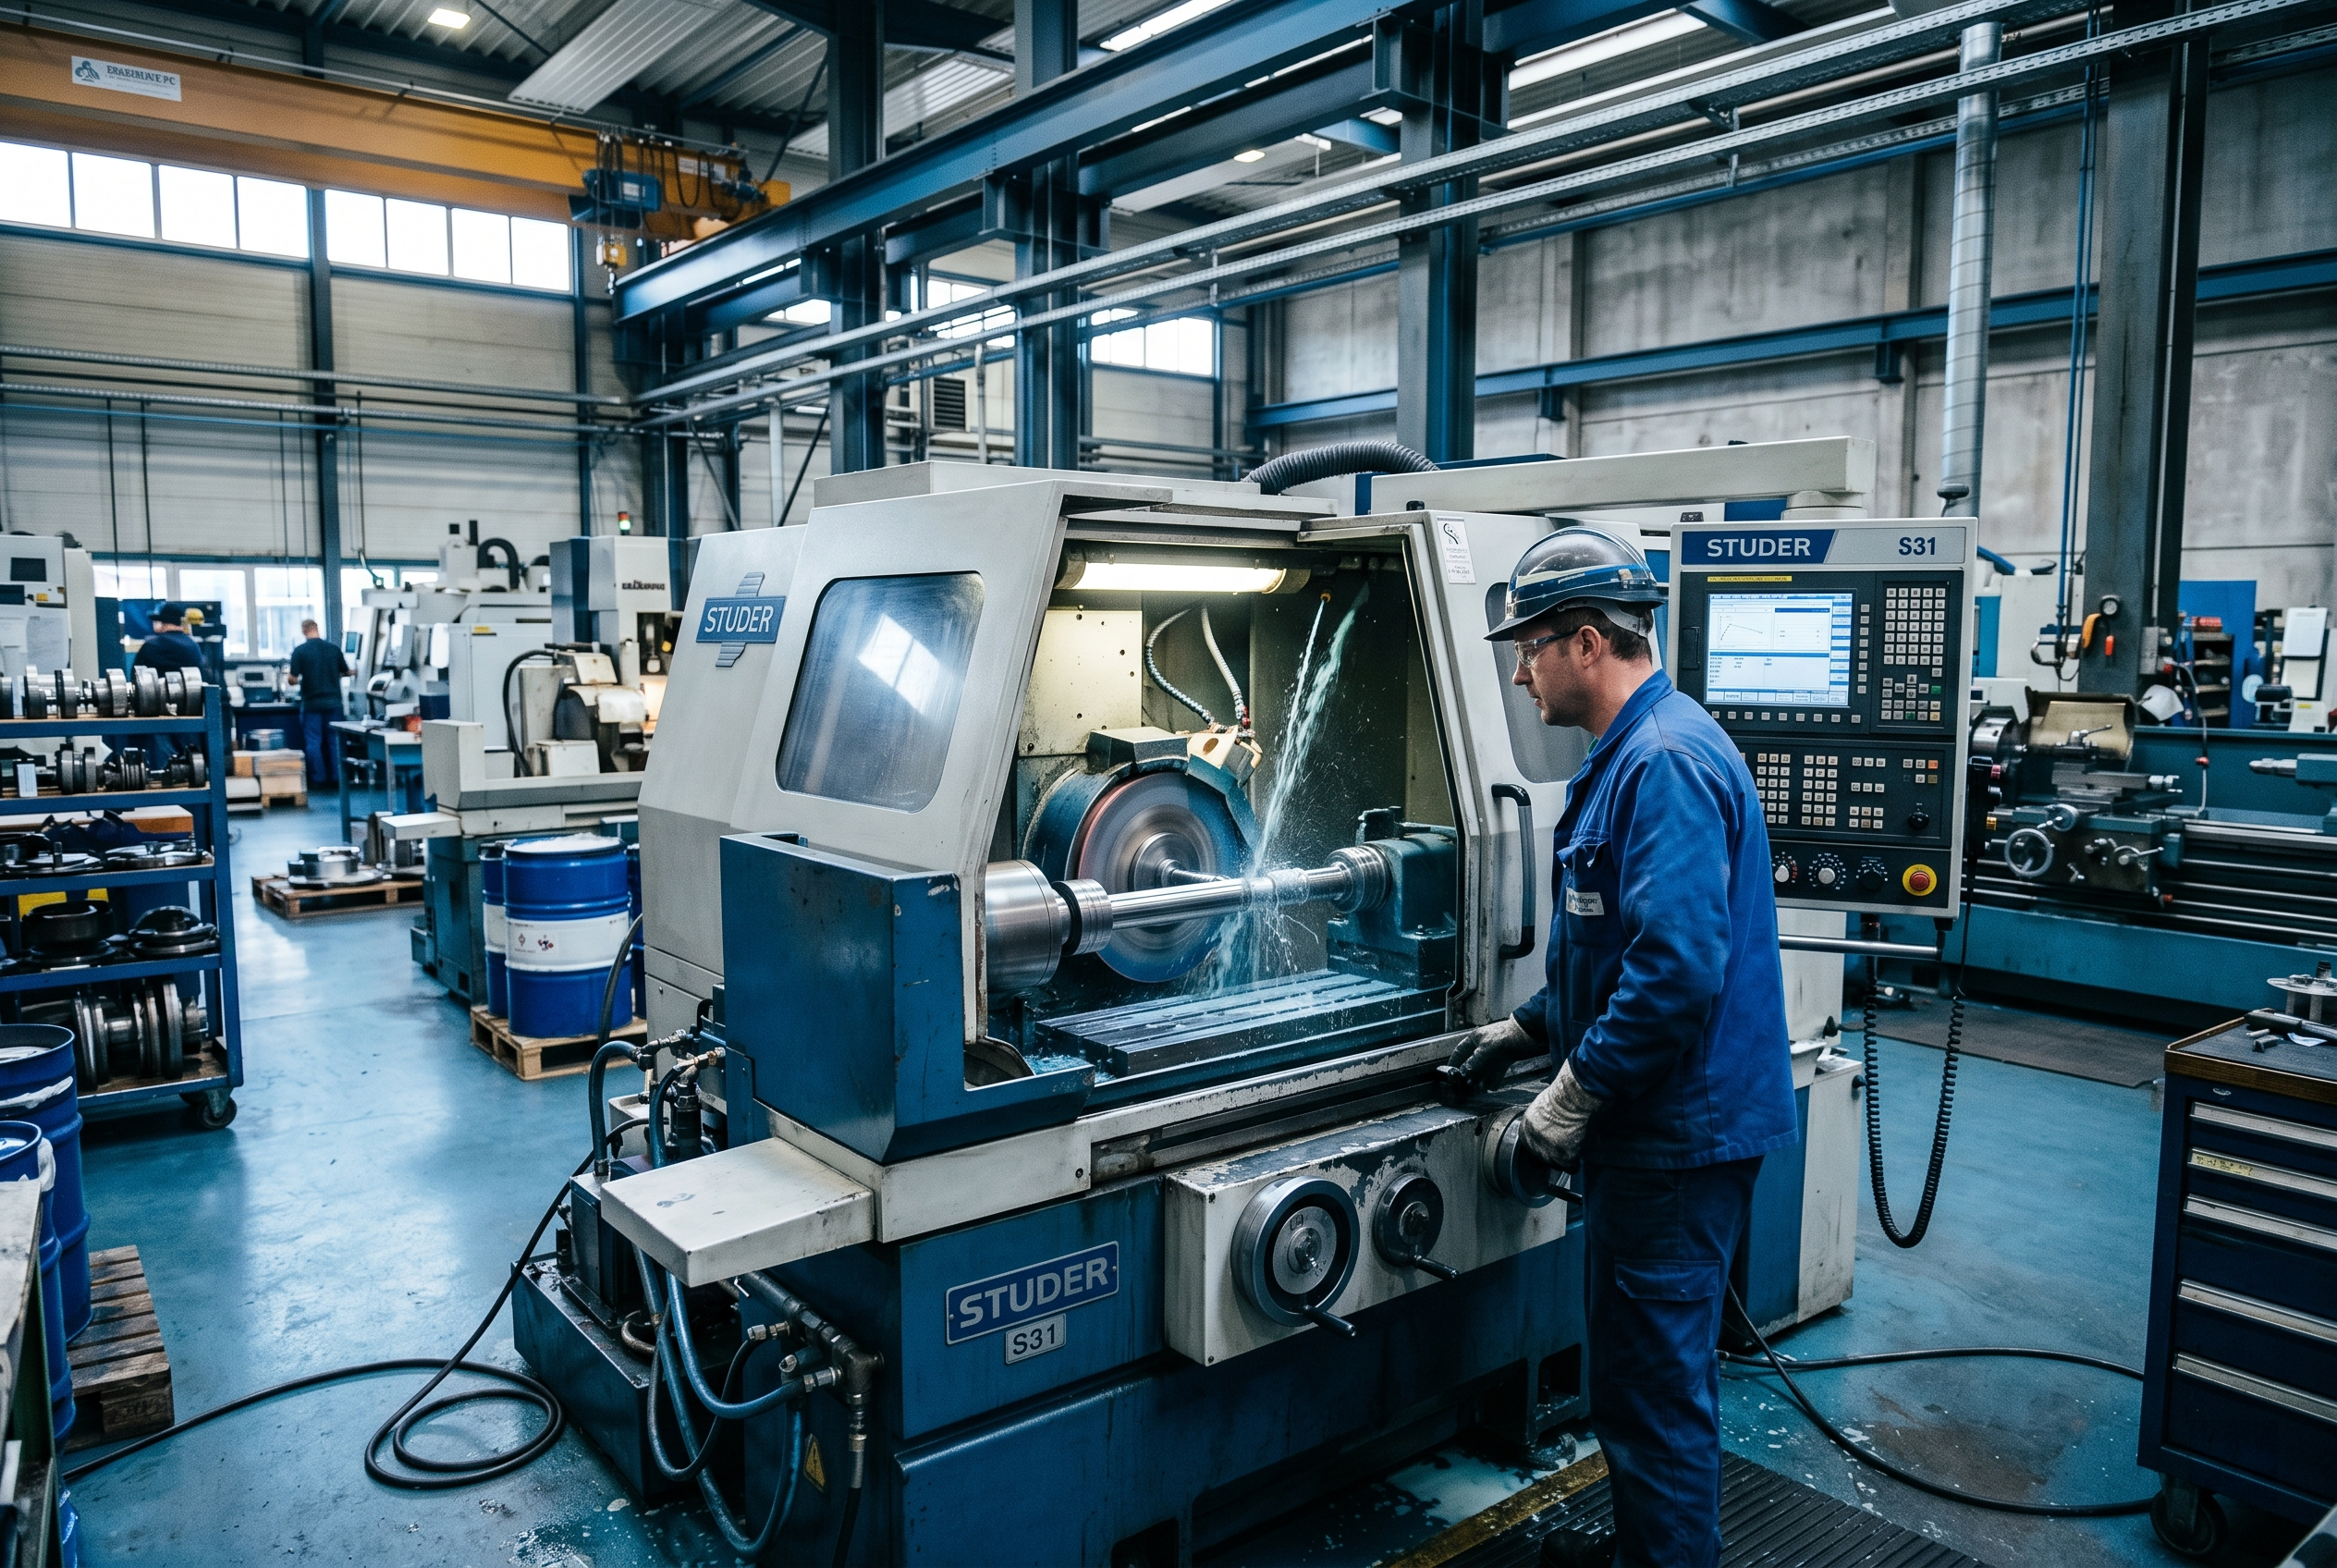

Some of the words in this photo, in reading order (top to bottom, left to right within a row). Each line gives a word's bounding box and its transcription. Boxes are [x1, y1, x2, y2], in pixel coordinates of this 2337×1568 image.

[1707, 537, 1811, 557] STUDER
[1898, 536, 1936, 556] S31
[704, 606, 774, 633] STUDER
[960, 1256, 1108, 1329] STUDER
[1012, 1323, 1055, 1355] S31
